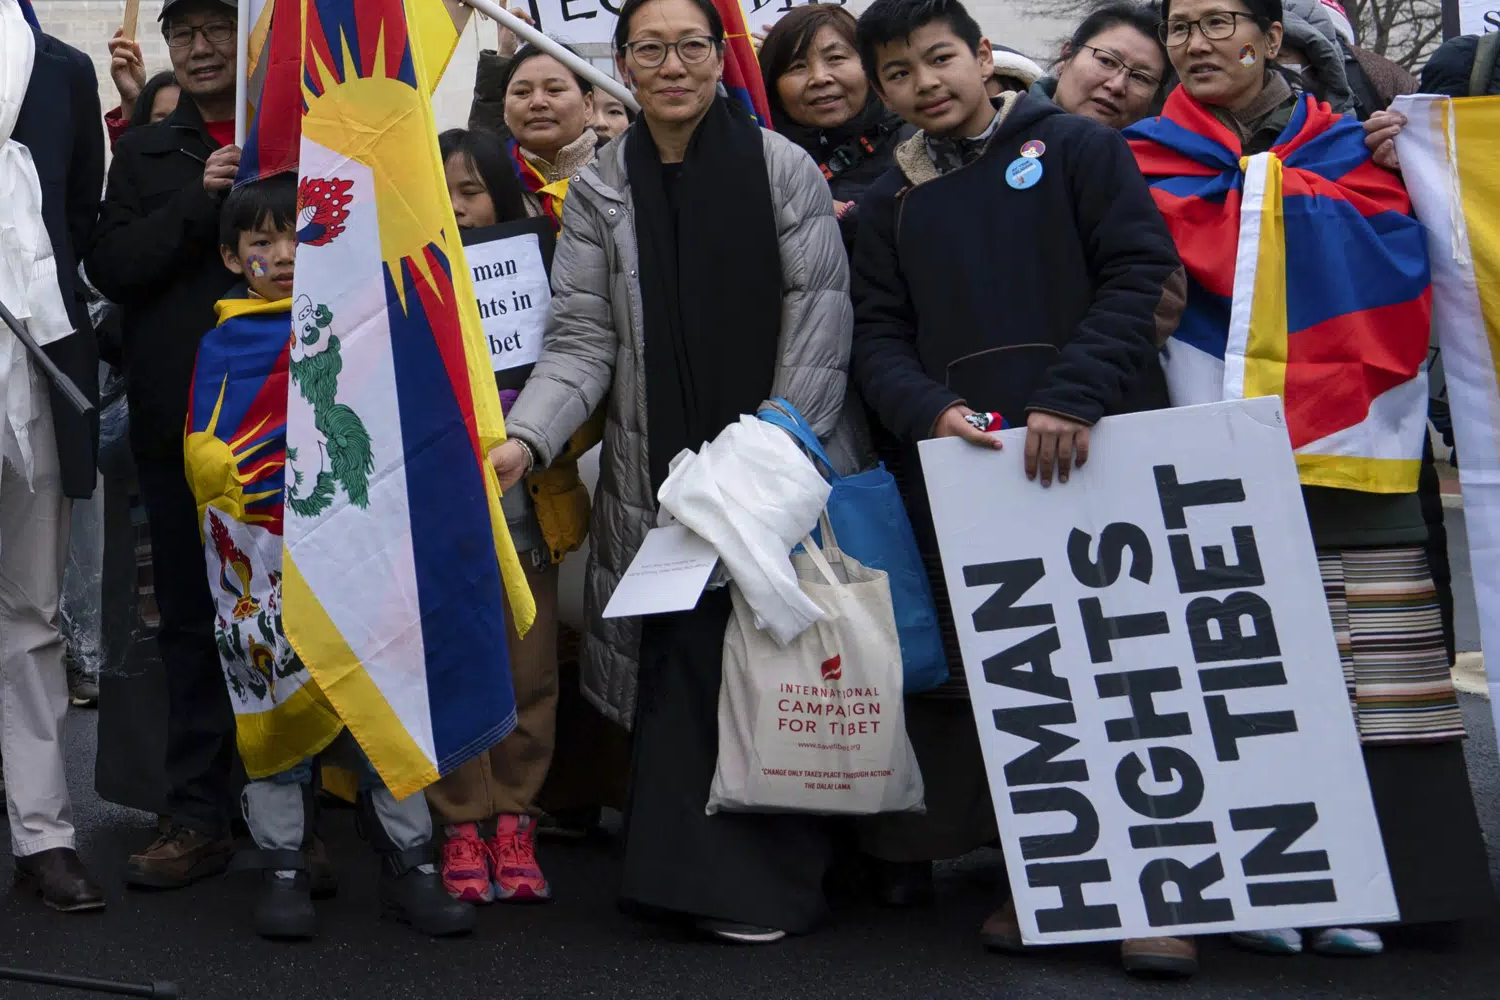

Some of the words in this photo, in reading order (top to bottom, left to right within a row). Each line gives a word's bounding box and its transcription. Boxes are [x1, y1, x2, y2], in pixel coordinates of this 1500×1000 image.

[472, 258, 518, 282] man
[476, 298, 508, 319] hts
[511, 290, 533, 312] in
[486, 329, 522, 356] bet
[1152, 464, 1299, 762] TIBET
[780, 683, 879, 700] INTERNATIONAL
[778, 699, 881, 718] CAMPAIGN
[778, 718, 816, 733] FOR
[829, 721, 880, 736] TIBET
[1066, 521, 1235, 928] RIGHTS
[797, 741, 861, 751] www.savetibet.org
[962, 557, 1123, 934] HUMAN
[788, 769, 803, 777] ONLY
[804, 770, 822, 778] TAKES
[823, 771, 841, 779] PLACE
[842, 771, 869, 779] THROUGH
[1228, 802, 1338, 907] IN
